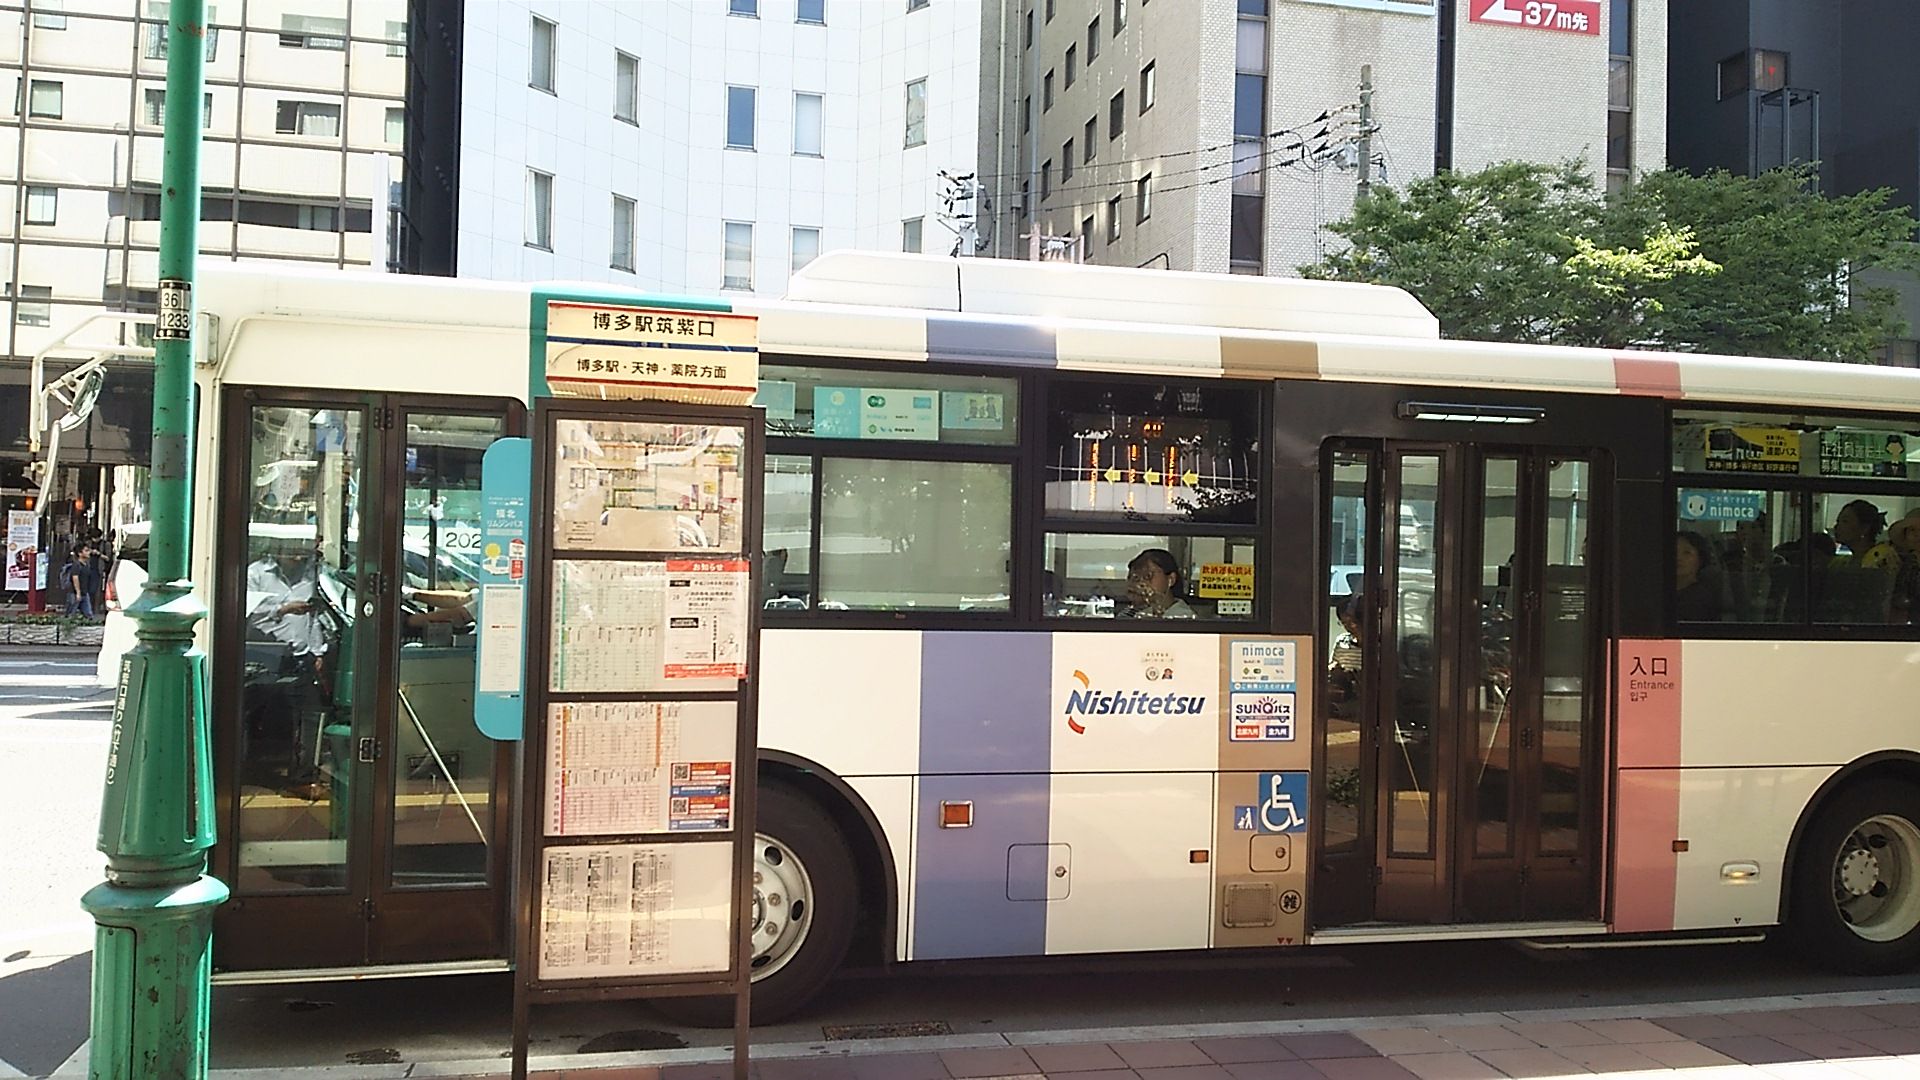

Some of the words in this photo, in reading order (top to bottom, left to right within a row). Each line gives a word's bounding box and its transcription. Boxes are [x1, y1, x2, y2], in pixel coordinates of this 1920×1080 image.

[1525, 1, 1588, 31] 37m先
[163, 292, 178, 308] 36
[162, 313, 189, 329] 1233
[592, 311, 716, 338] 博多駅筑紫口
[577, 358, 727, 379] 博多駅・天神・薬院方面
[1710, 503, 1754, 517] nimoca
[693, 563, 724, 571] お知らせ
[1242, 644, 1285, 656] nimoca
[1630, 656, 1667, 676] 入口
[1630, 680, 1675, 690] Entrance
[1065, 689, 1206, 715] Nishitetsu
[1630, 691, 1648, 702] 입구
